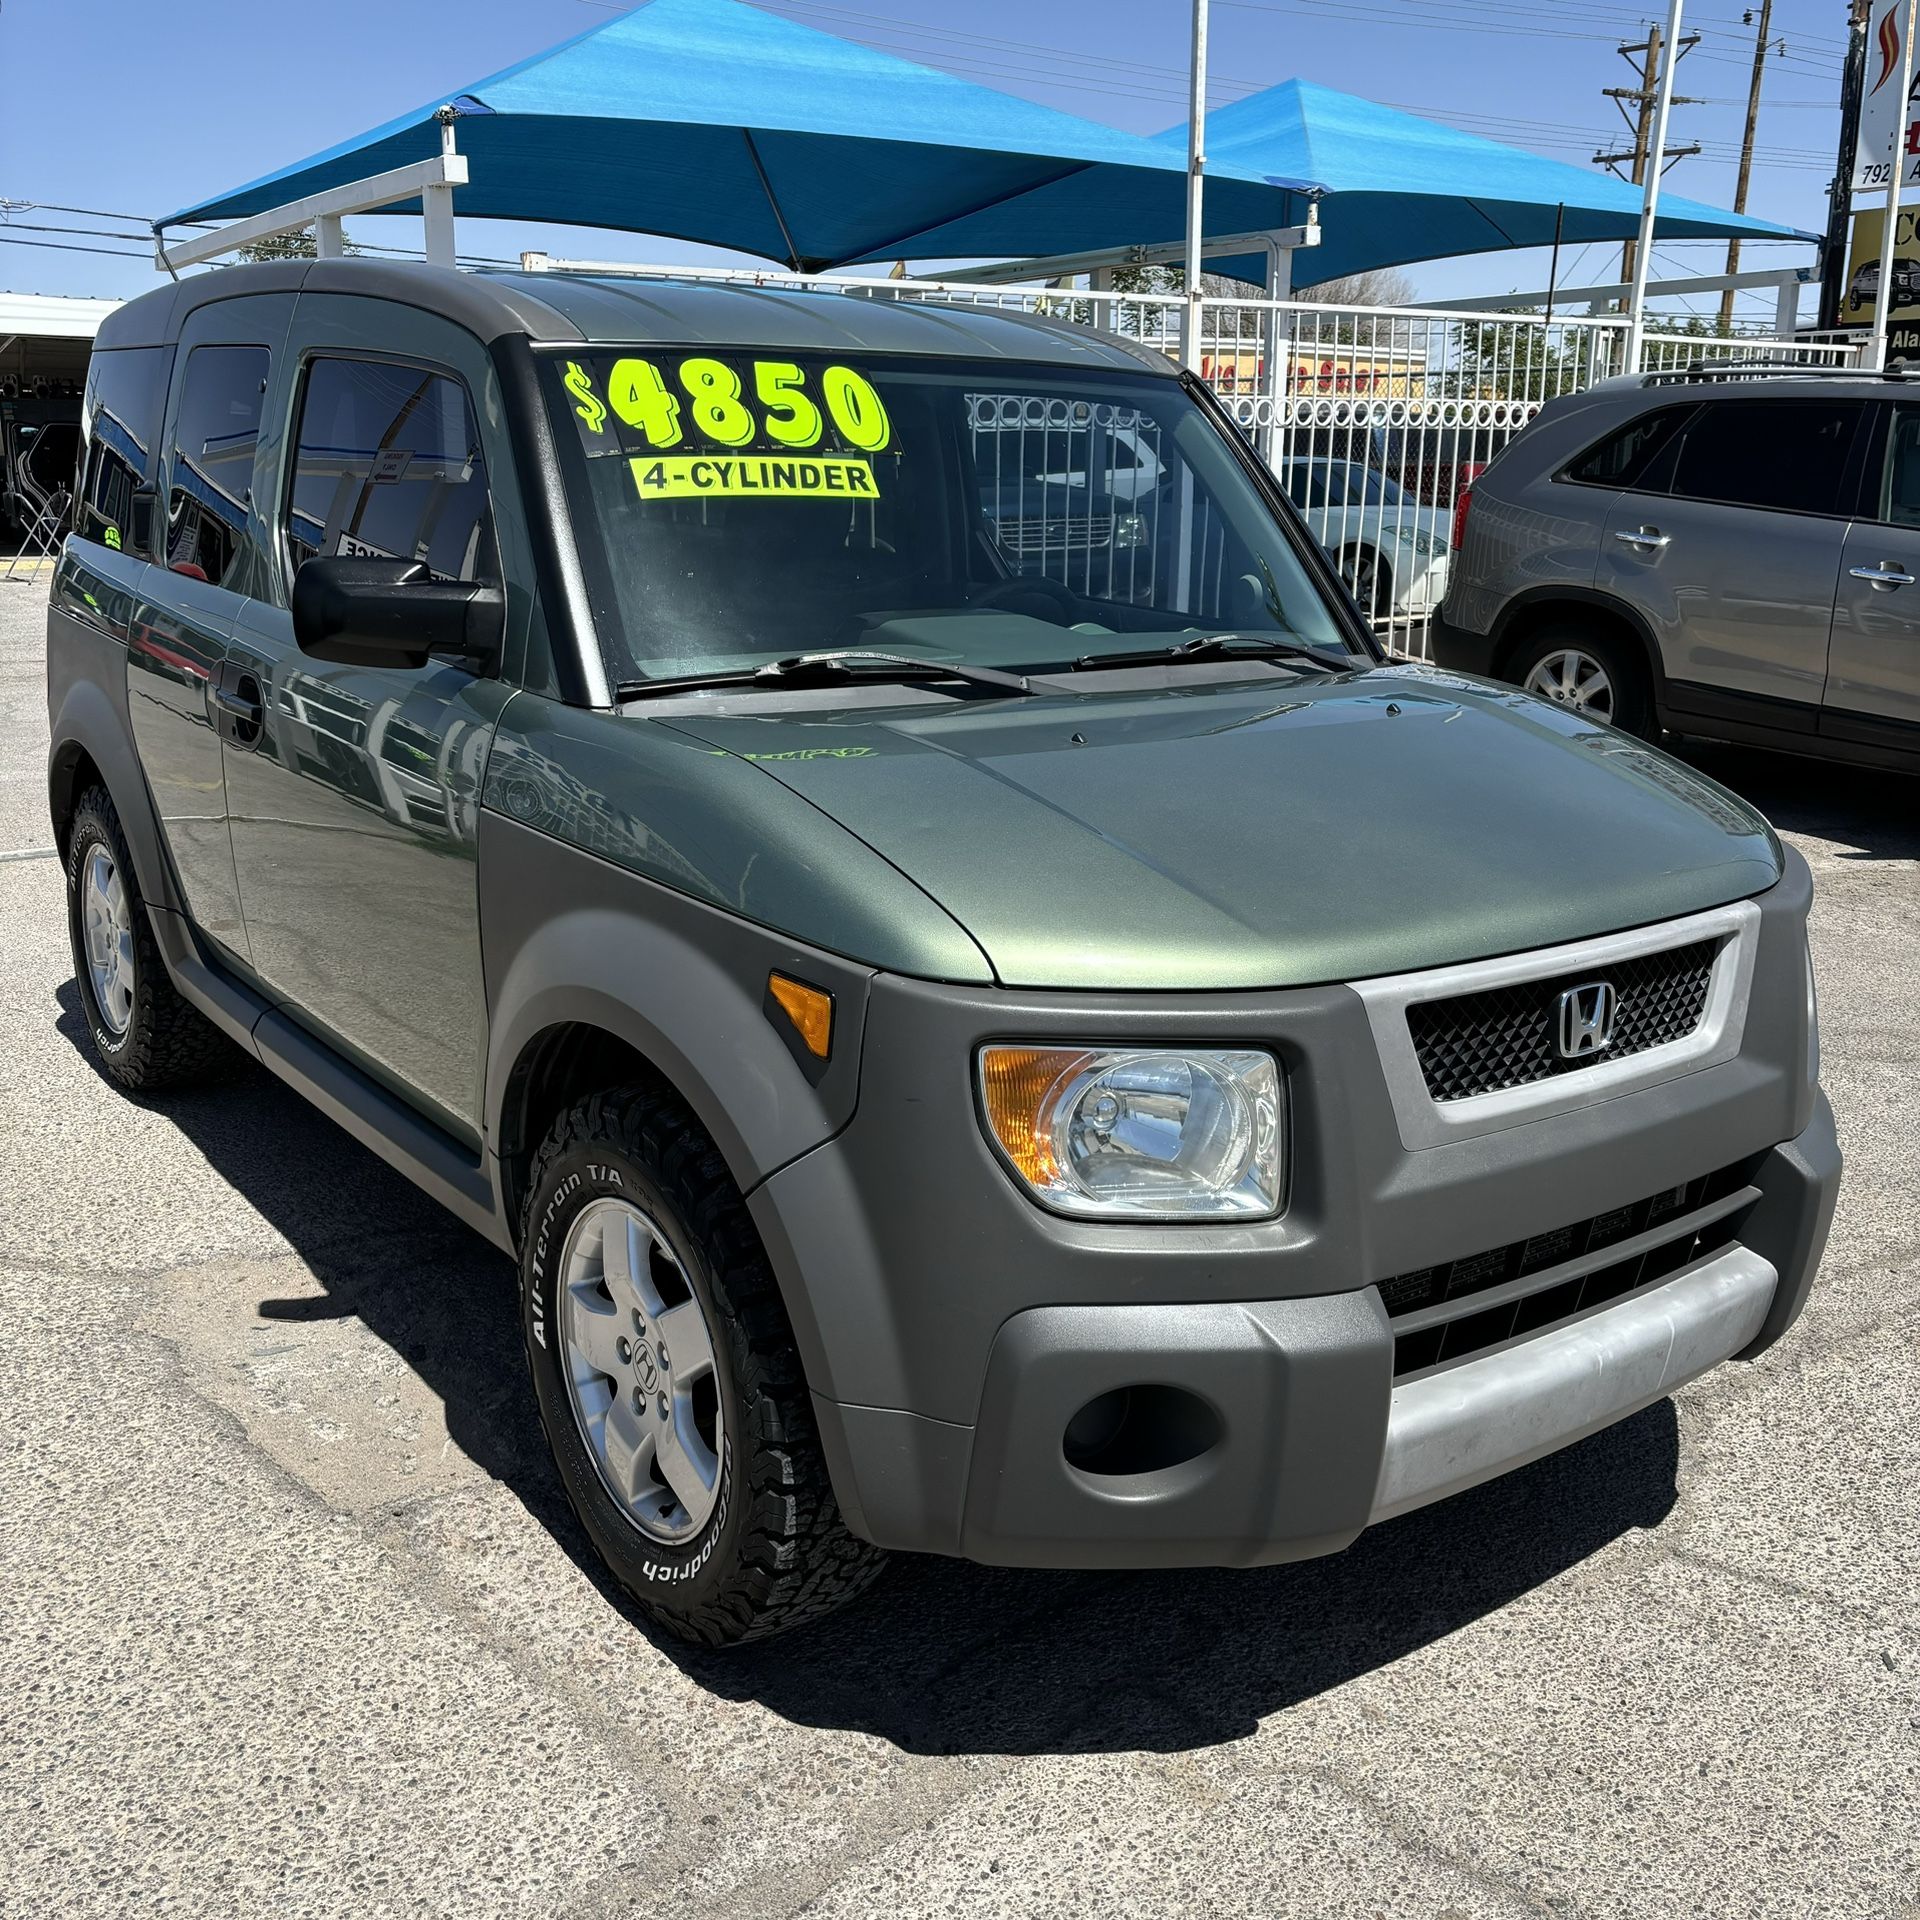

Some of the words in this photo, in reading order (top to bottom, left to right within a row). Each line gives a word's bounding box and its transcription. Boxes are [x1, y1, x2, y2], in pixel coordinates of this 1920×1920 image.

[1892, 330, 1920, 348] Ala
[643, 461, 873, 493] 4-CYLINDER
[532, 1172, 582, 1350] All-Terrain
